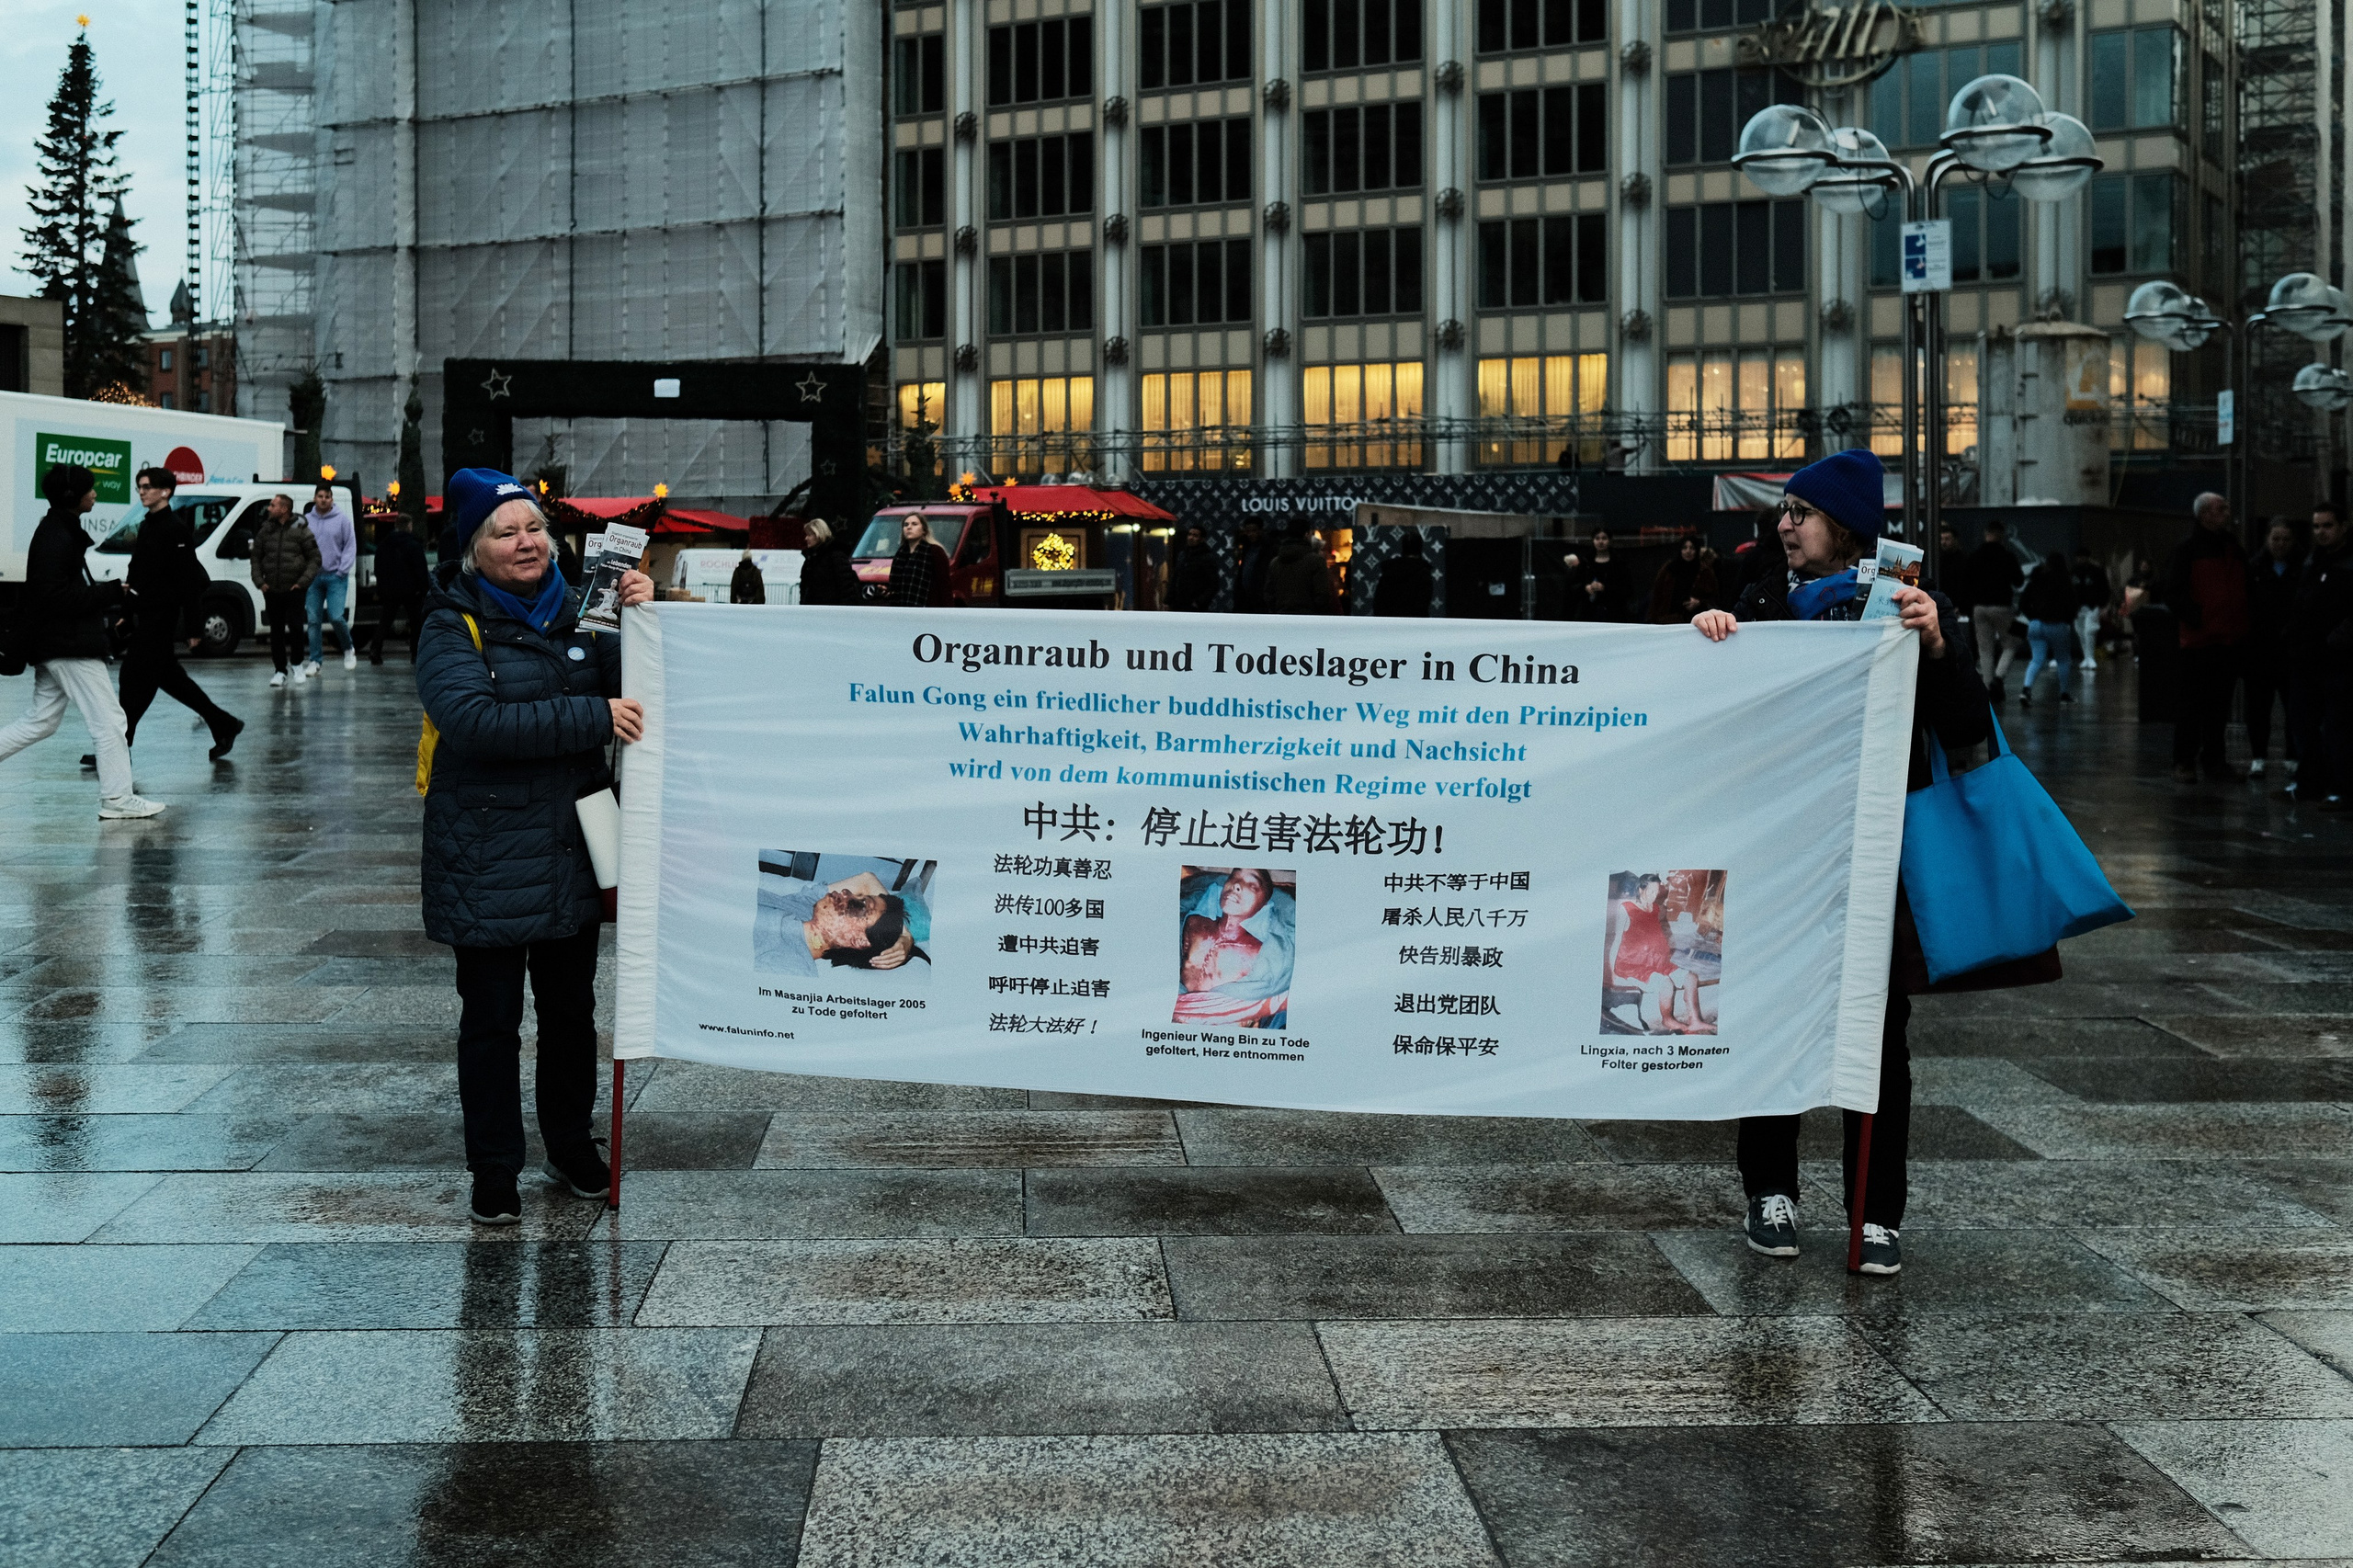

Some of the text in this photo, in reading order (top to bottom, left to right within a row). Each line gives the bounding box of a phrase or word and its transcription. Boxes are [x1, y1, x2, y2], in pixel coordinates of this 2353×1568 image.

[45, 443, 123, 468] Europcar
[102, 480, 121, 491] way
[1241, 497, 1290, 513] LOUIS
[608, 534, 642, 550] Organraub
[912, 632, 1580, 687] Organraub und Todeslager in China
[849, 682, 1648, 733] Falun Gong ein friedlicher buddhistischer Weg mit den Prinzipien
[958, 721, 1528, 763] Wahrhaftigkeit, Barmherzigkeit und Nachsicht
[948, 757, 1533, 804] wird von dem kommunistischen Regime verfolgt
[993, 853, 1113, 881] 法轮功真善忍
[1383, 870, 1530, 894] 中共不等于中国
[994, 892, 1105, 920] 洪传100多国
[1381, 905, 1529, 928] 屠杀人民八千万
[997, 933, 1100, 958] 遭中共迫害
[1398, 945, 1505, 969] 快告别暴政
[758, 986, 926, 1010] Im Masanjia Arbeitslager 2005
[988, 975, 1111, 999] 呼吁停止迫害
[791, 1006, 888, 1020] zu Tode gefoltert
[1393, 992, 1502, 1017] 退出党团队
[698, 1023, 795, 1040] www.faluninfo.net
[1141, 1028, 1311, 1049] Ingenieur Wang Bin zu Tode
[1145, 1044, 1305, 1062] gefoltert, Herz entnommen
[1392, 1033, 1500, 1057] 保命保平安
[1580, 1044, 1731, 1058] Lingxia, nach 3 Monaten
[1601, 1059, 1704, 1074] Folter gestorben
